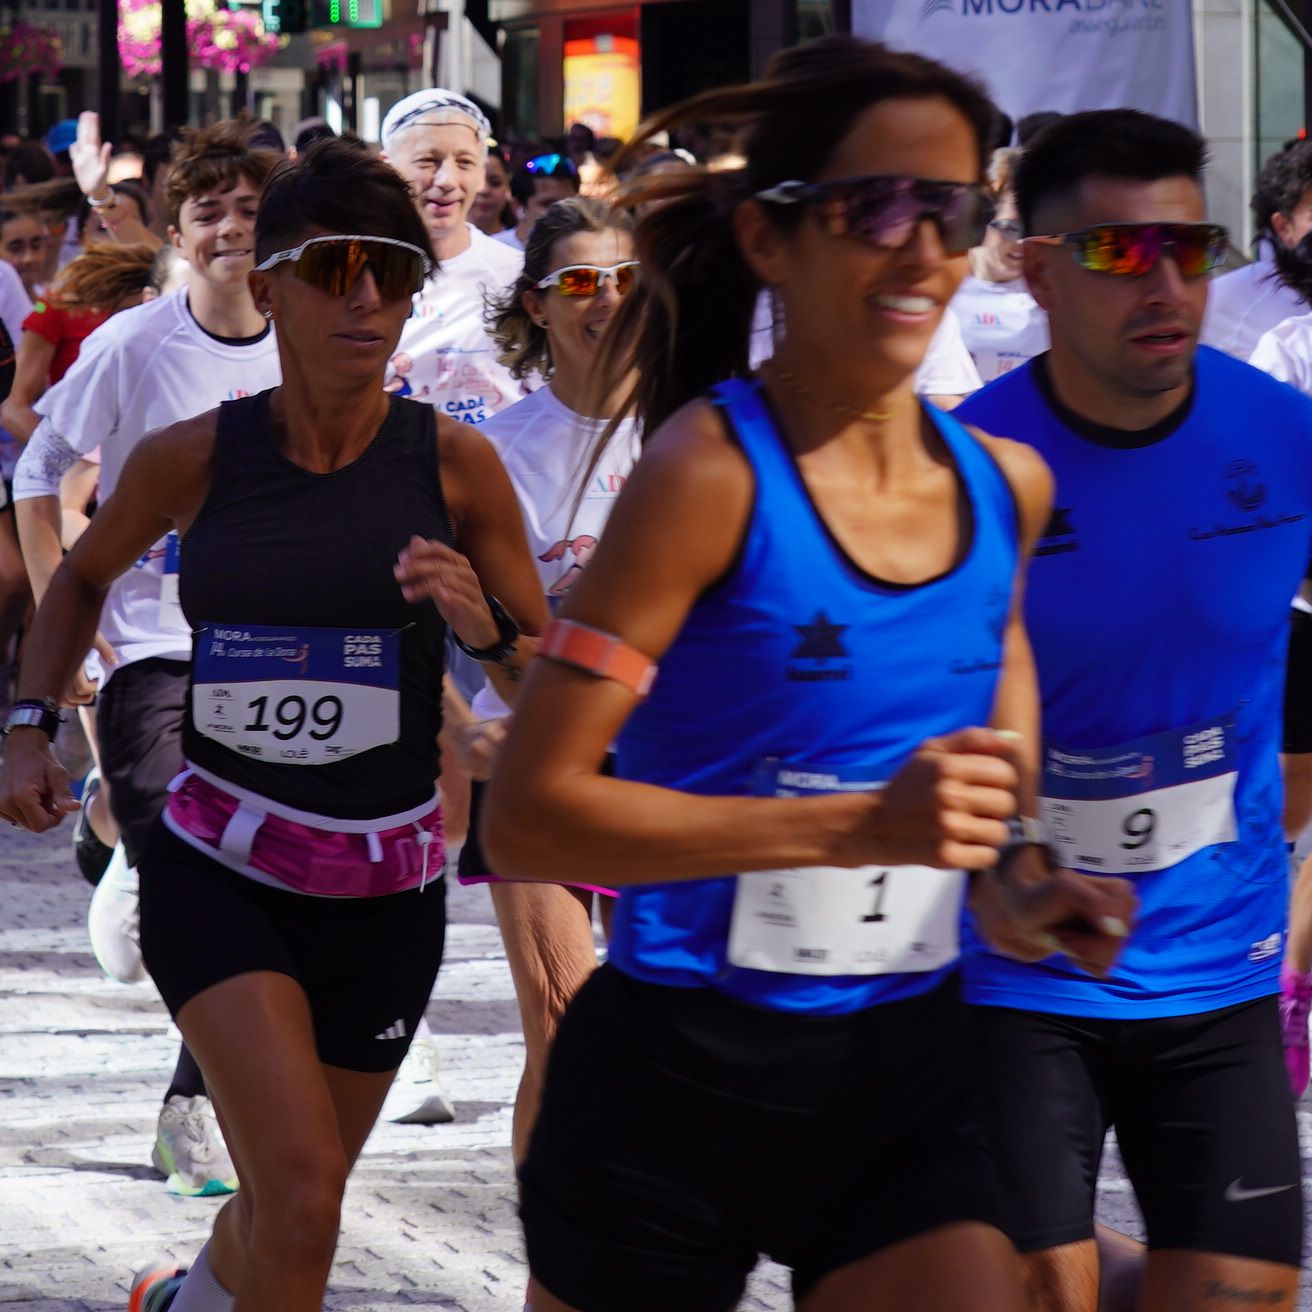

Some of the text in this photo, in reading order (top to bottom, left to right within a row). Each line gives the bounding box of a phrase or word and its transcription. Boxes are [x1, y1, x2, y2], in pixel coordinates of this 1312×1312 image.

[214, 629, 251, 641] MORA
[343, 635, 382, 644] CADA
[343, 644, 382, 655] PAS
[343, 656, 382, 667] SUMA
[244, 695, 344, 741] 199
[1121, 808, 1155, 849] 9
[859, 870, 890, 923] 1
